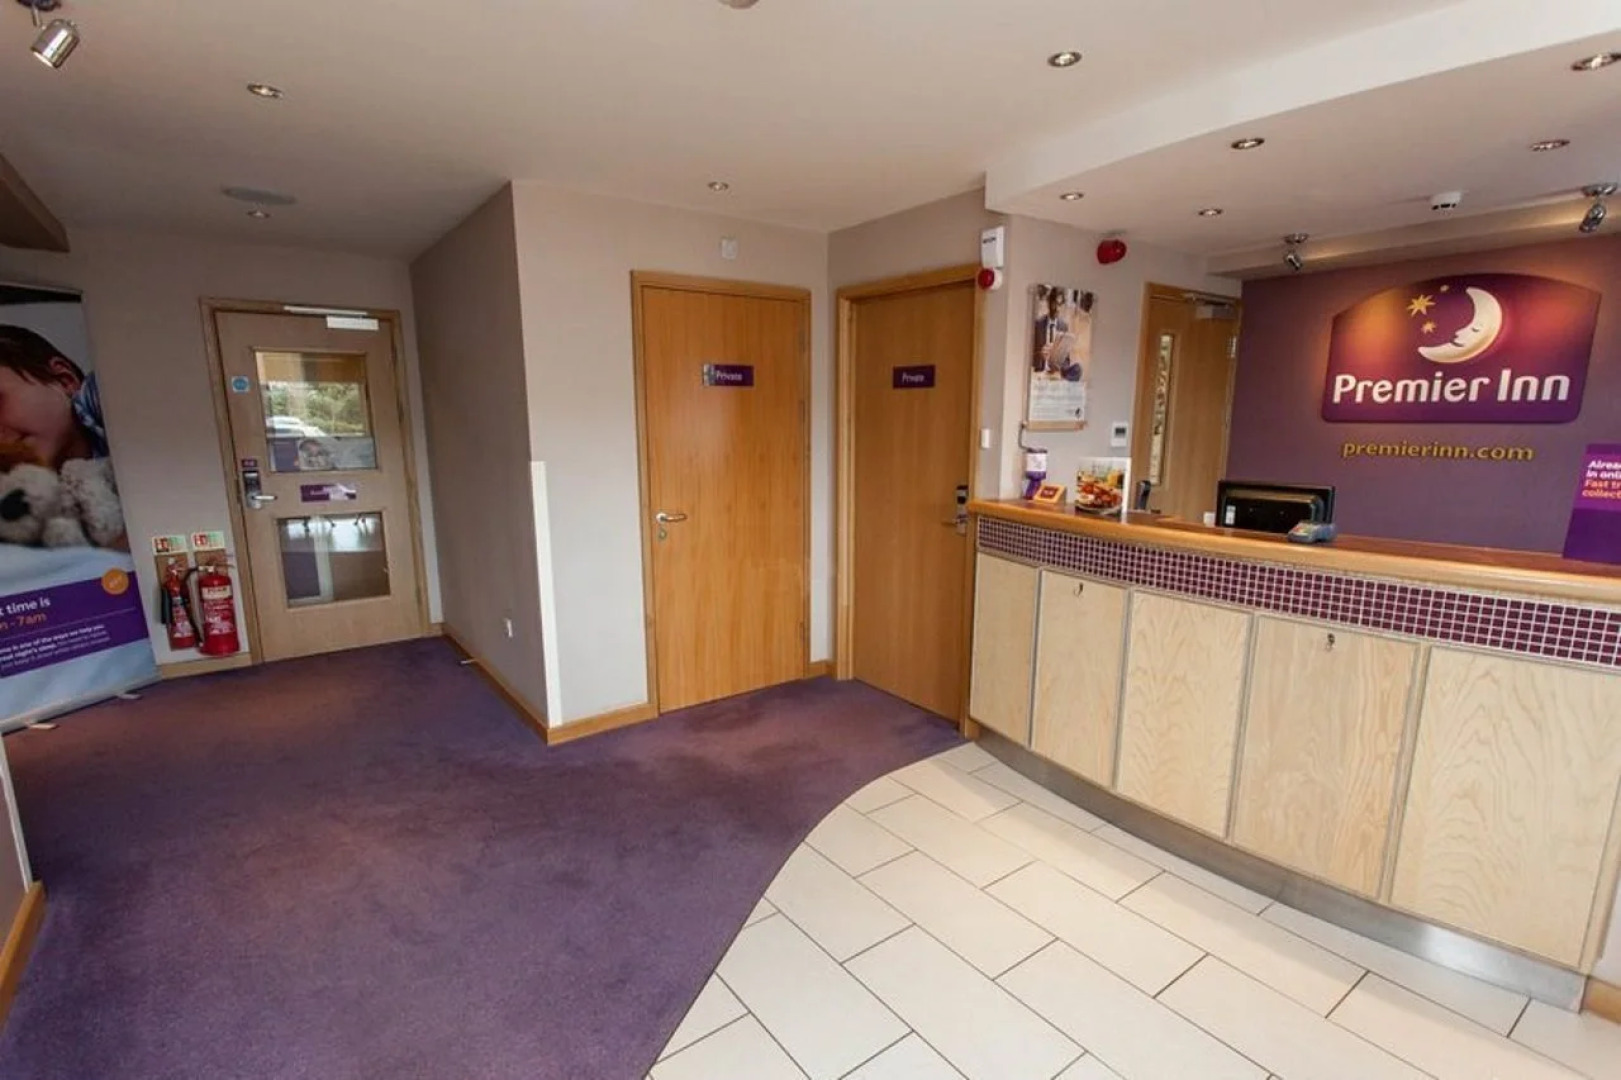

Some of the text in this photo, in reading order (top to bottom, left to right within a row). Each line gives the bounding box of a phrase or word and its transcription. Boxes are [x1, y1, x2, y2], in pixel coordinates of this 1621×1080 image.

[716, 370, 743, 381] Private
[902, 371, 925, 383] Private
[1332, 368, 1571, 404] Premier Inn
[1342, 440, 1535, 461] premierinn.com
[1584, 479, 1609, 488] Fast
[6, 600, 38, 614] time
[40, 597, 51, 608] is
[16, 613, 47, 626] 7am
